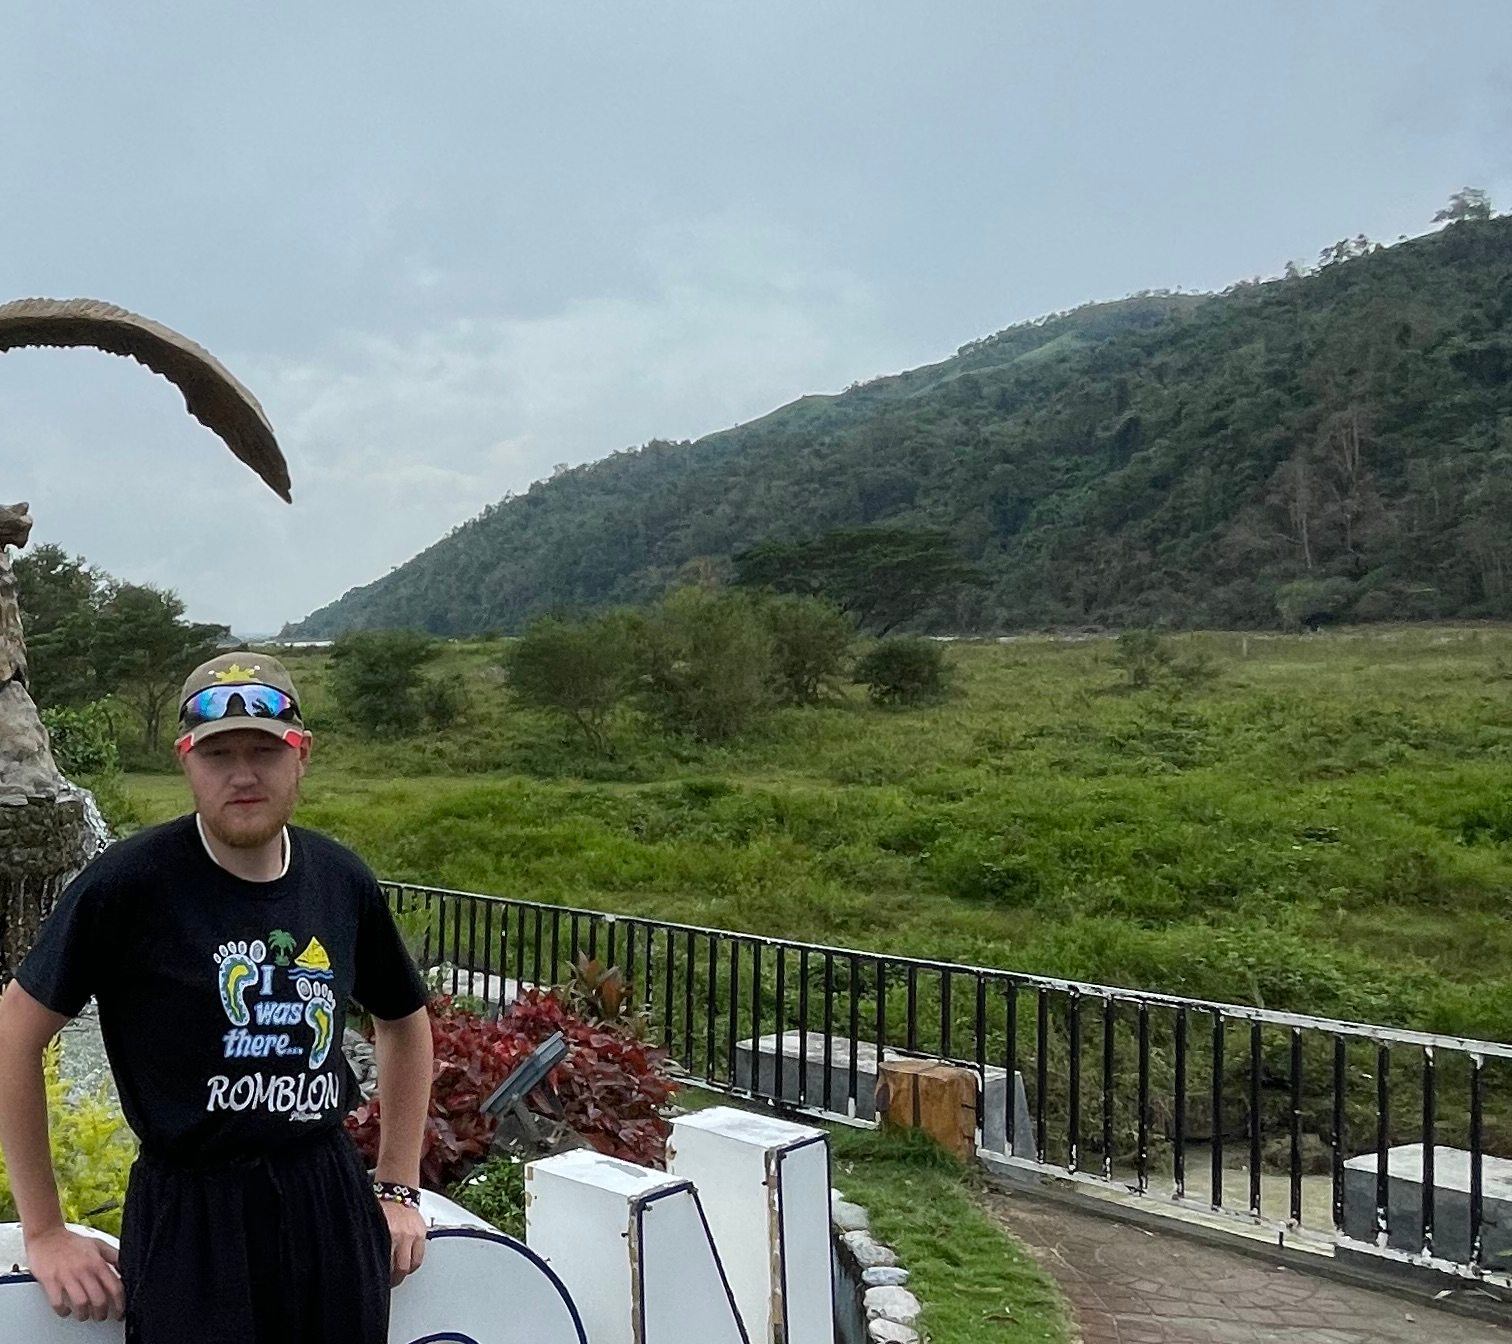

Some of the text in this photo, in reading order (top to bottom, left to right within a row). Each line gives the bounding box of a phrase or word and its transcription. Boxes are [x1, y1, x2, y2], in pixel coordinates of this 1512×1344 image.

[259, 964, 275, 996] I
[254, 1001, 304, 1026] was
[206, 1072, 339, 1112] ROMBLON
